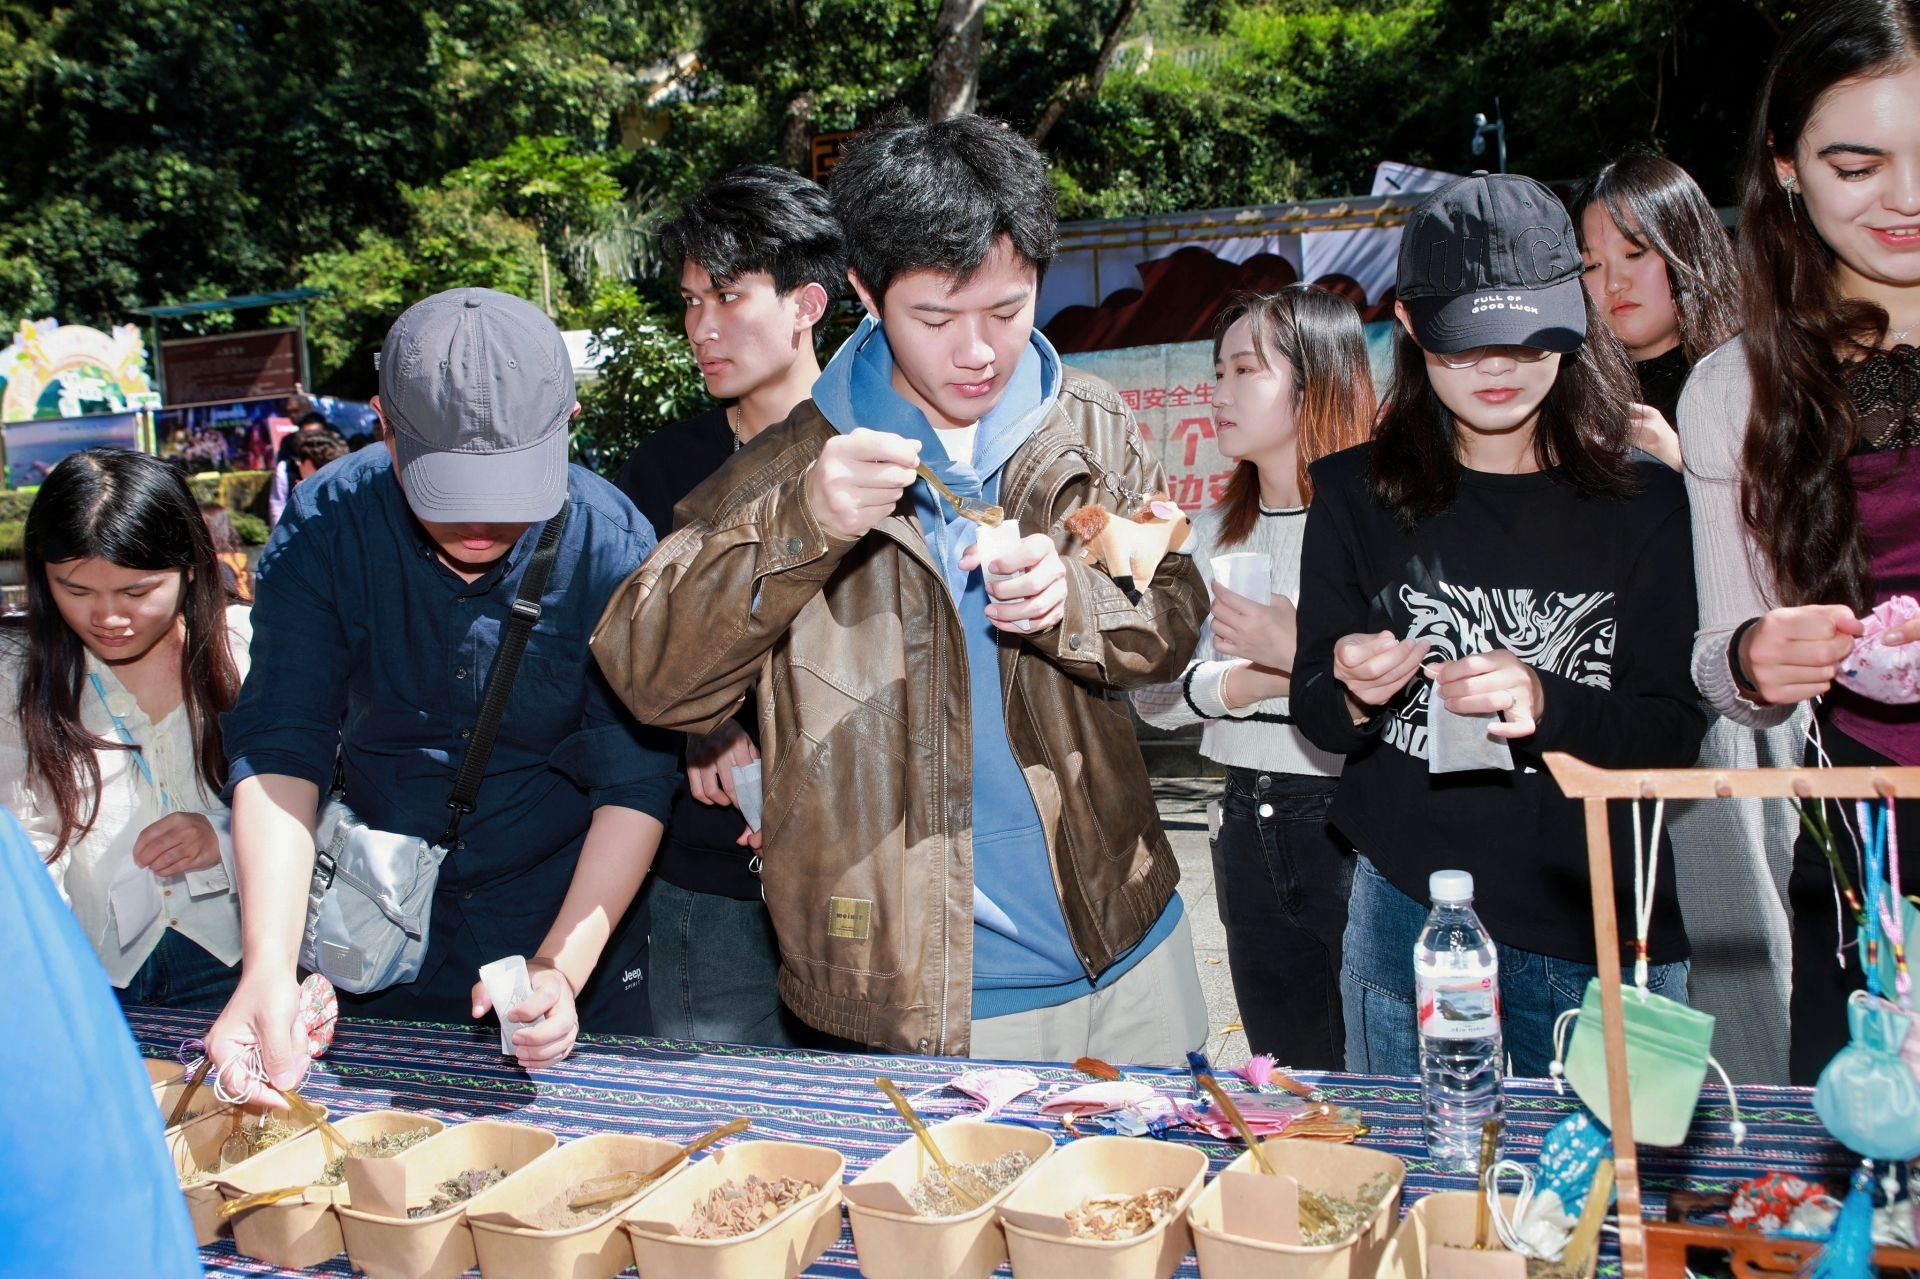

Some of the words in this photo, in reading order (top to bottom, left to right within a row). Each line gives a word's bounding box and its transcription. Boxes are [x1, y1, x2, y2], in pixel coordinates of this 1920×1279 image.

[1473, 294, 1503, 306] FULL
[1471, 303, 1505, 314] GOOD
[1509, 303, 1539, 315] LUCK
[622, 967, 642, 983] Jeep
